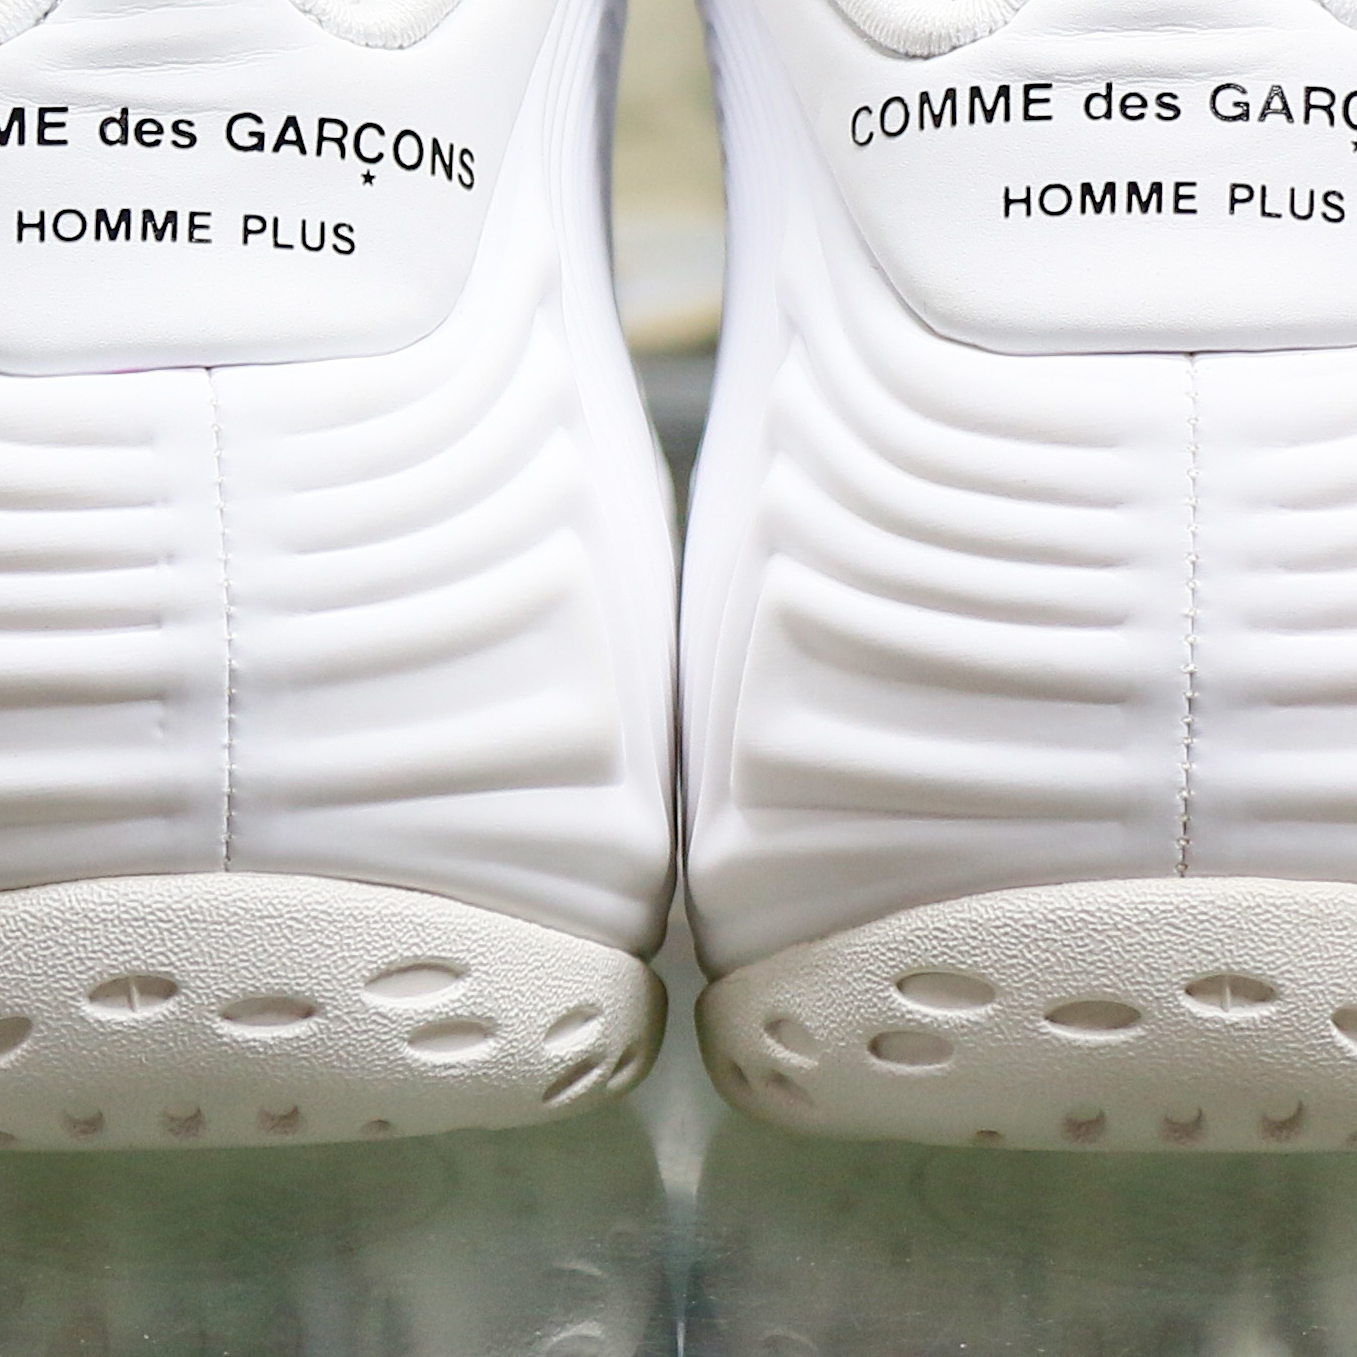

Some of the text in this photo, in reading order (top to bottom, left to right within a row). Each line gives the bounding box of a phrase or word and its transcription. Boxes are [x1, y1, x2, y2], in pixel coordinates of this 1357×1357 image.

[98, 105, 198, 149] des
[850, 82, 1054, 148] COMME
[1082, 80, 1182, 122] des
[1002, 181, 1346, 222] HOMME PLUS
[15, 208, 357, 256] HOMME PLUS
